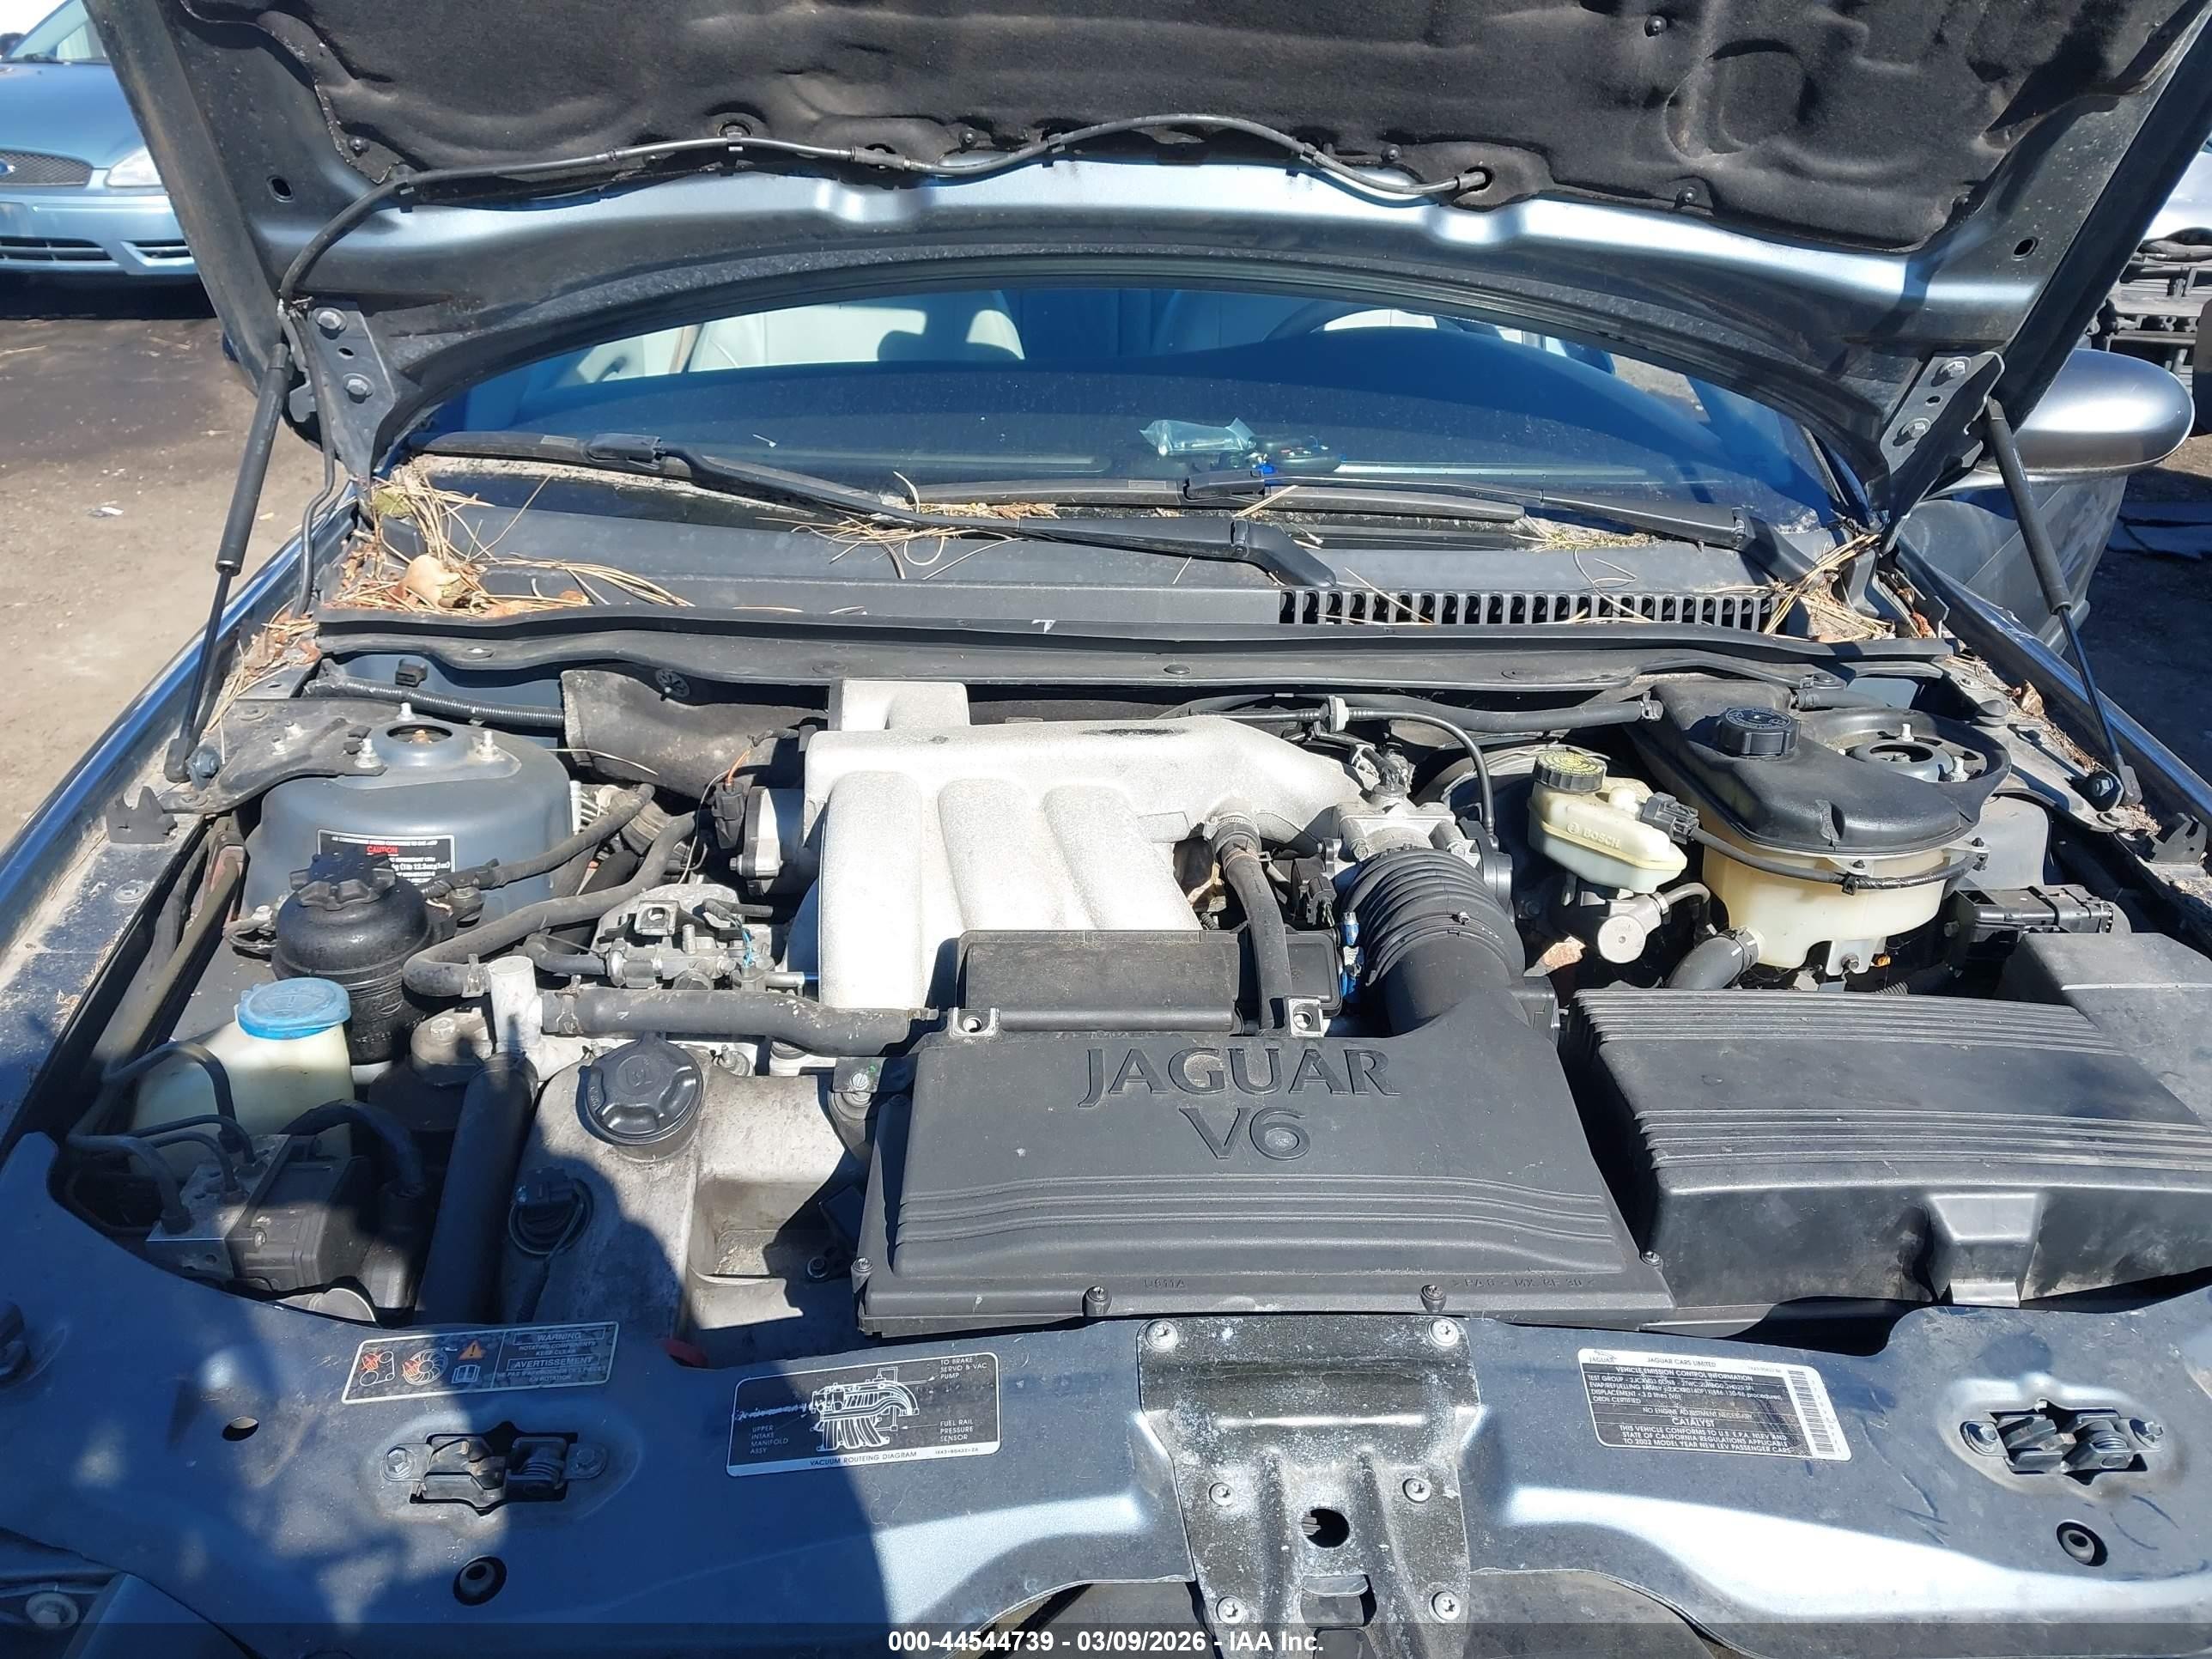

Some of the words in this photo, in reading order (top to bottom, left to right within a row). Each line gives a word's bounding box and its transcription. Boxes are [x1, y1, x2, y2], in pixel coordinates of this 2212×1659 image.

[1583, 830, 1621, 850] BOSCH
[1078, 1047, 1401, 1109] JAGUAR
[1177, 1106, 1311, 1161] V6
[514, 1357, 592, 1369] AVERTISSEMENT
[1589, 1355, 1615, 1364] JAGUAR
[1676, 1370, 1707, 1378] CONTROL
[1709, 1372, 1753, 1382] INFORMATION
[1591, 1389, 1636, 1397] DISPLACEMENT
[1680, 1408, 1717, 1418] ADJUSTMENT
[1672, 1417, 1715, 1427] CATALYST
[940, 1425, 974, 1434] PRESSURE
[1666, 1427, 1706, 1436] CONFORMS
[750, 1437, 788, 1447] MANIFOLD
[940, 1433, 968, 1443] SENSOR
[1655, 1433, 1698, 1442] CALIFORNIA
[1699, 1436, 1747, 1444] REGULATIONS
[1748, 1439, 1788, 1448] APPLICABLE
[1731, 1443, 1771, 1452] PASSENGER
[810, 1458, 841, 1467] VACUUM
[843, 1455, 879, 1463] ROUTEING
[882, 1451, 917, 1460] DIAGRAM
